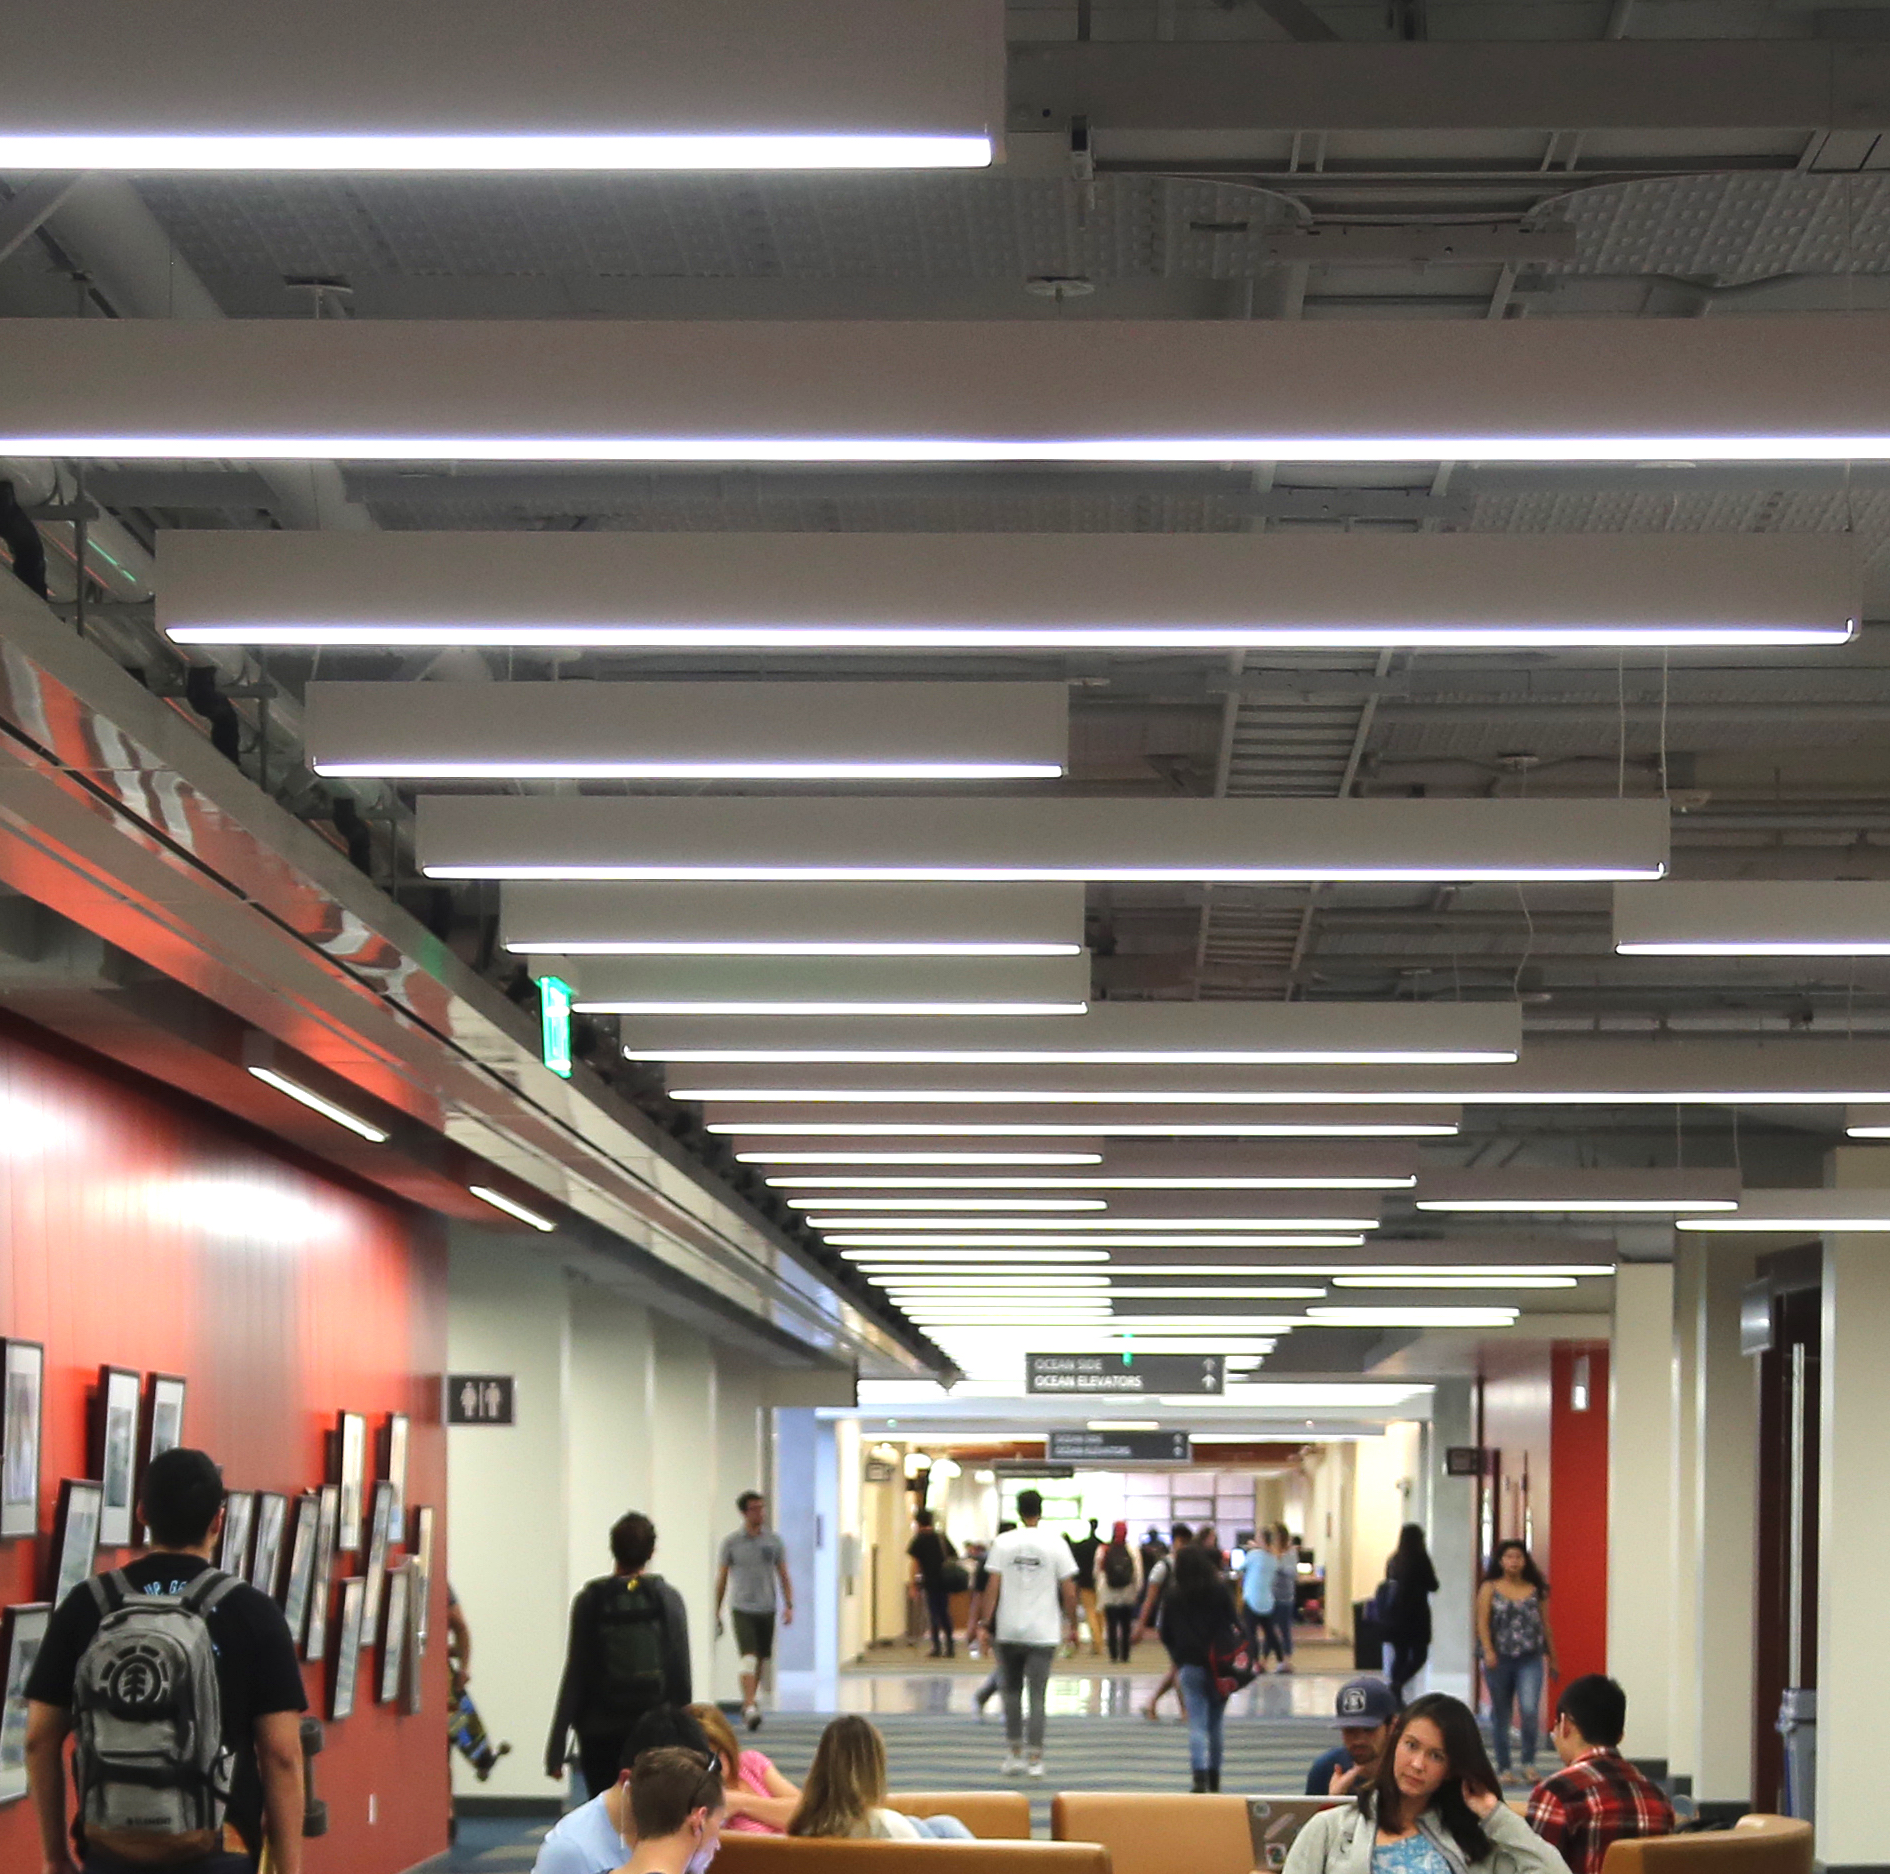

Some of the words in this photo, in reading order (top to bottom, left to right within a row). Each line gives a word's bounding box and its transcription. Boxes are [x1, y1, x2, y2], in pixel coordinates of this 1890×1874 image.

[1034, 1358, 1075, 1370] OCEAN
[1076, 1358, 1103, 1370] SIDE
[1034, 1375, 1075, 1387] OCEAN
[1076, 1375, 1142, 1387] ELEVATORS
